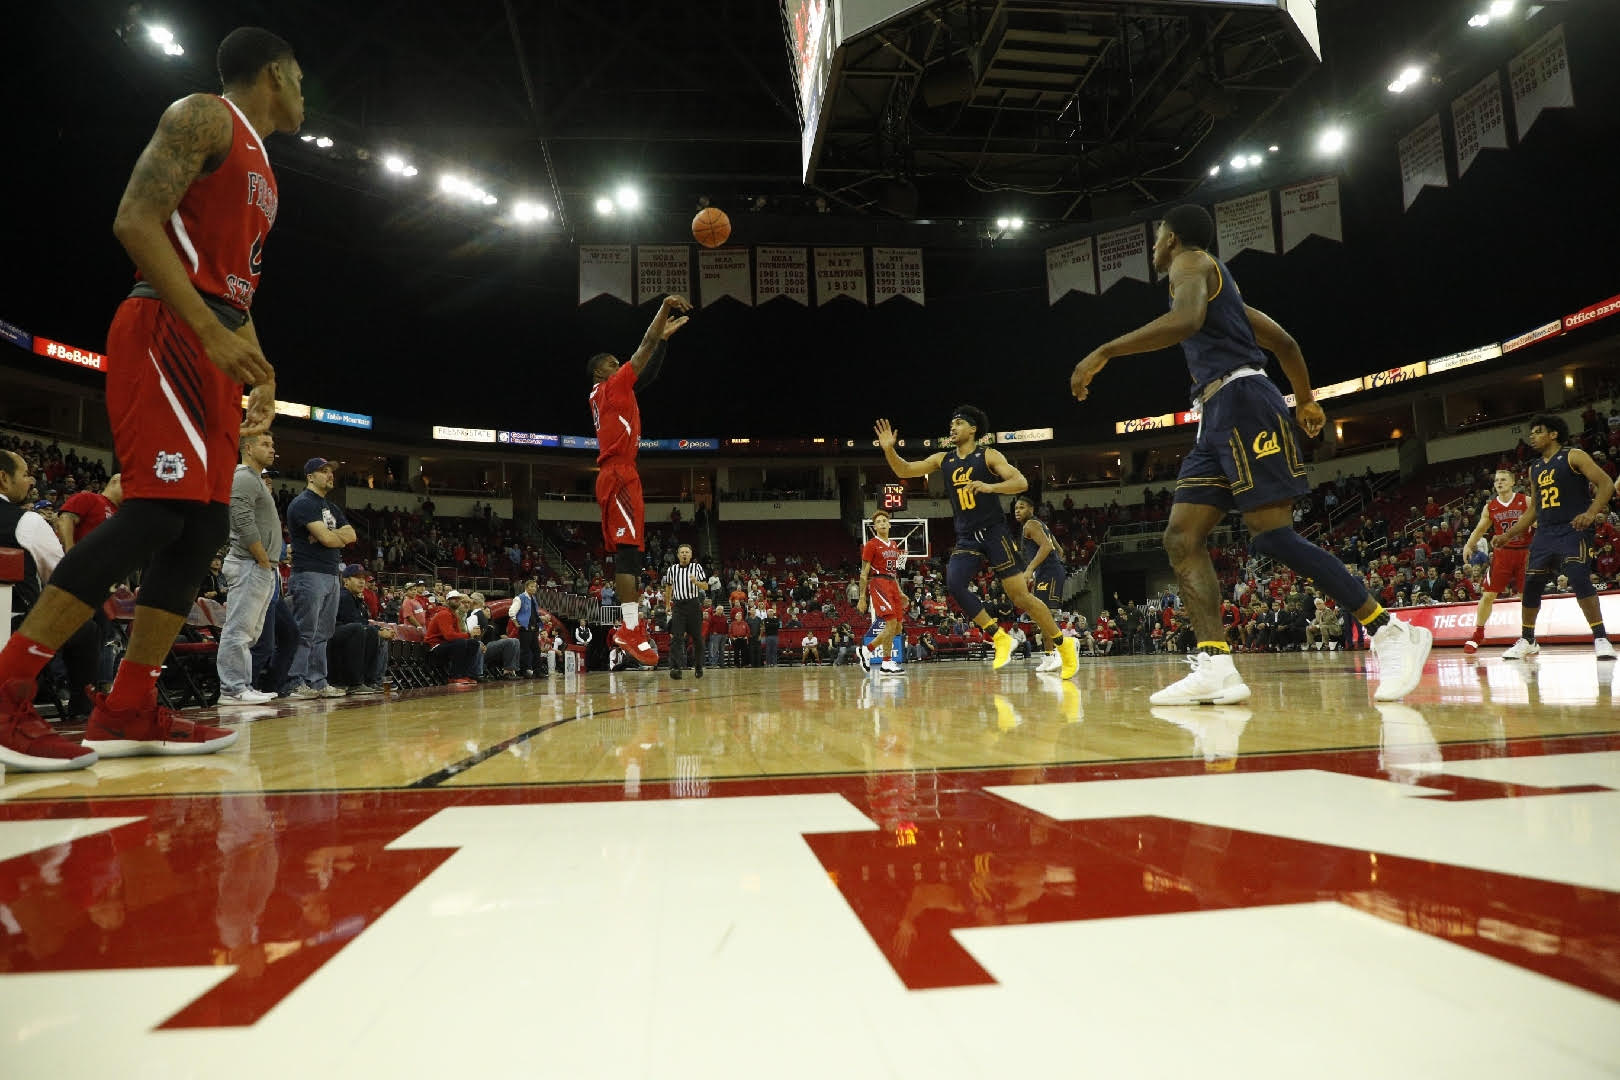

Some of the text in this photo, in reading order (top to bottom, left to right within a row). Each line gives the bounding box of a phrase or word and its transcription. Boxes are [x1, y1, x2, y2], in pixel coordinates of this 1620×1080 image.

[1072, 254, 1090, 264] 2017
[827, 281, 856, 290] 1983
[1565, 310, 1596, 327] Office
[47, 342, 101, 368] #BeBold
[1370, 368, 1416, 388] Coors
[1124, 417, 1163, 433] Coors
[639, 440, 659, 449] pepsi
[690, 440, 711, 449] pepsi
[1253, 431, 1281, 460] Cal
[952, 466, 974, 487] Cal
[1537, 468, 1555, 488] Cal
[884, 486, 904, 495] 17:42
[1541, 486, 1561, 509] 22
[885, 494, 902, 508] 24
[957, 487, 976, 511] 10
[1434, 614, 1457, 629] THE
